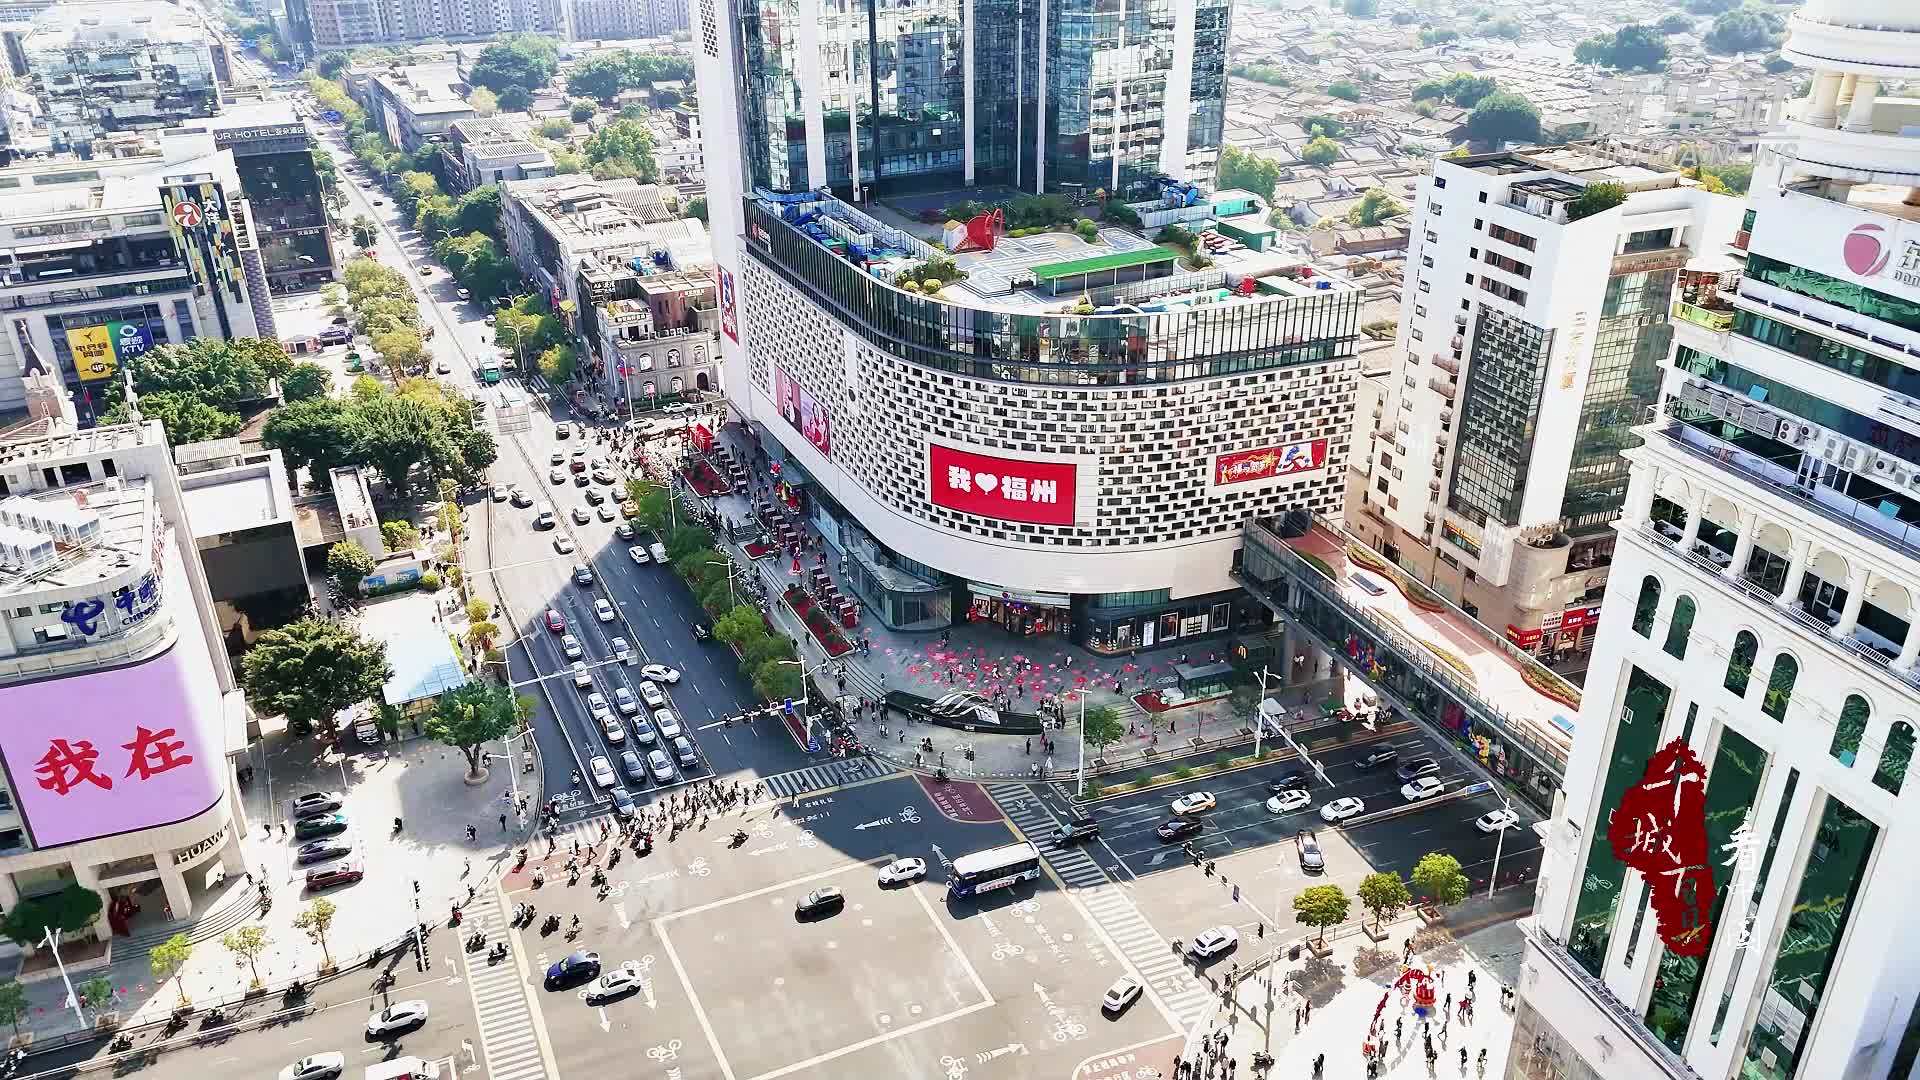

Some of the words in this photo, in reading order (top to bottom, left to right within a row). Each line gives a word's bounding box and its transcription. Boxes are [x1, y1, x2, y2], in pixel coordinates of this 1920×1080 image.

[235, 128, 275, 139] HOTEL
[121, 344, 144, 354] KTV
[948, 465, 972, 493] 我
[1001, 475, 1057, 504] 福州
[34, 725, 193, 796] 我在
